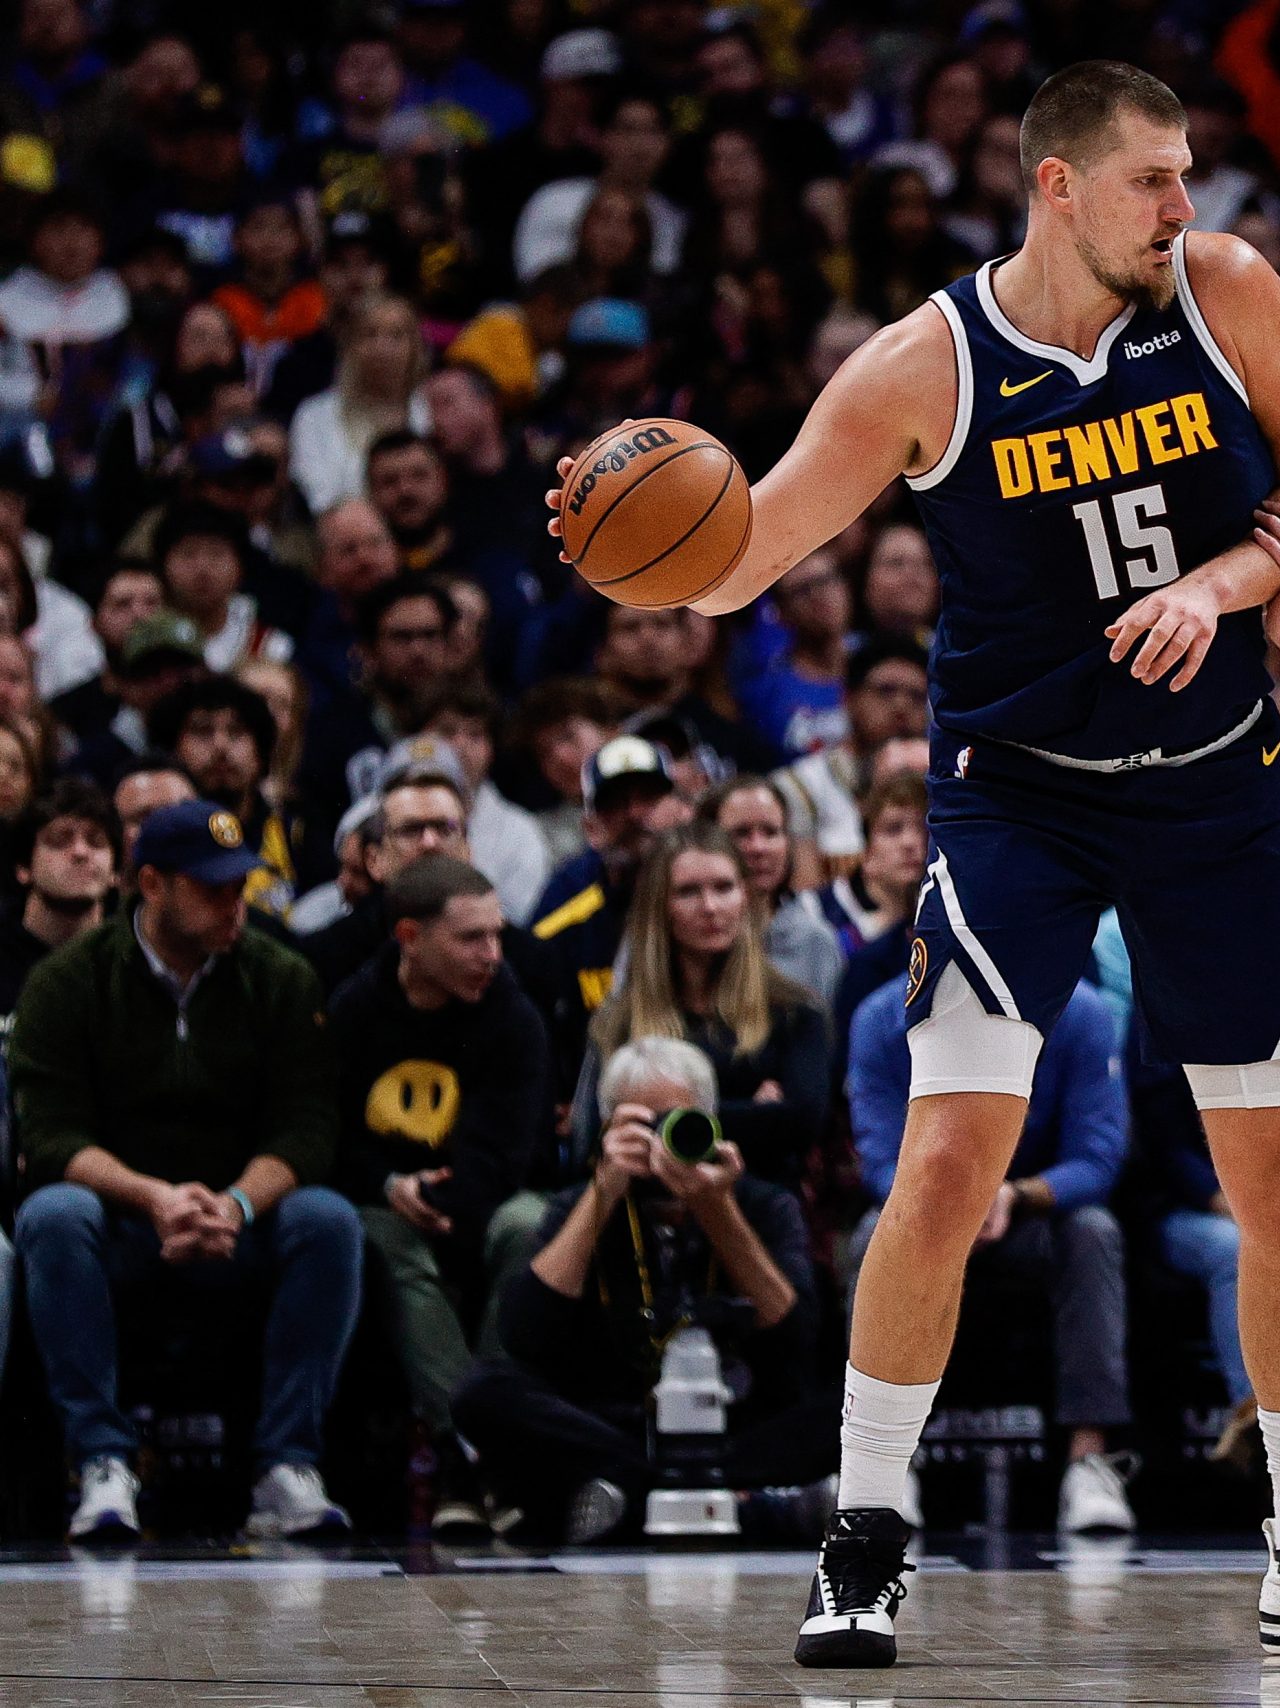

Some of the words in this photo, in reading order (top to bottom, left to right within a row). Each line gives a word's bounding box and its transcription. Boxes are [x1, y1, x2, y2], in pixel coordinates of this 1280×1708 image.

[1123, 329, 1182, 361] ibotta
[569, 426, 678, 516] Wilson
[990, 391, 1220, 500] DENVER
[1071, 483, 1182, 601] 15
